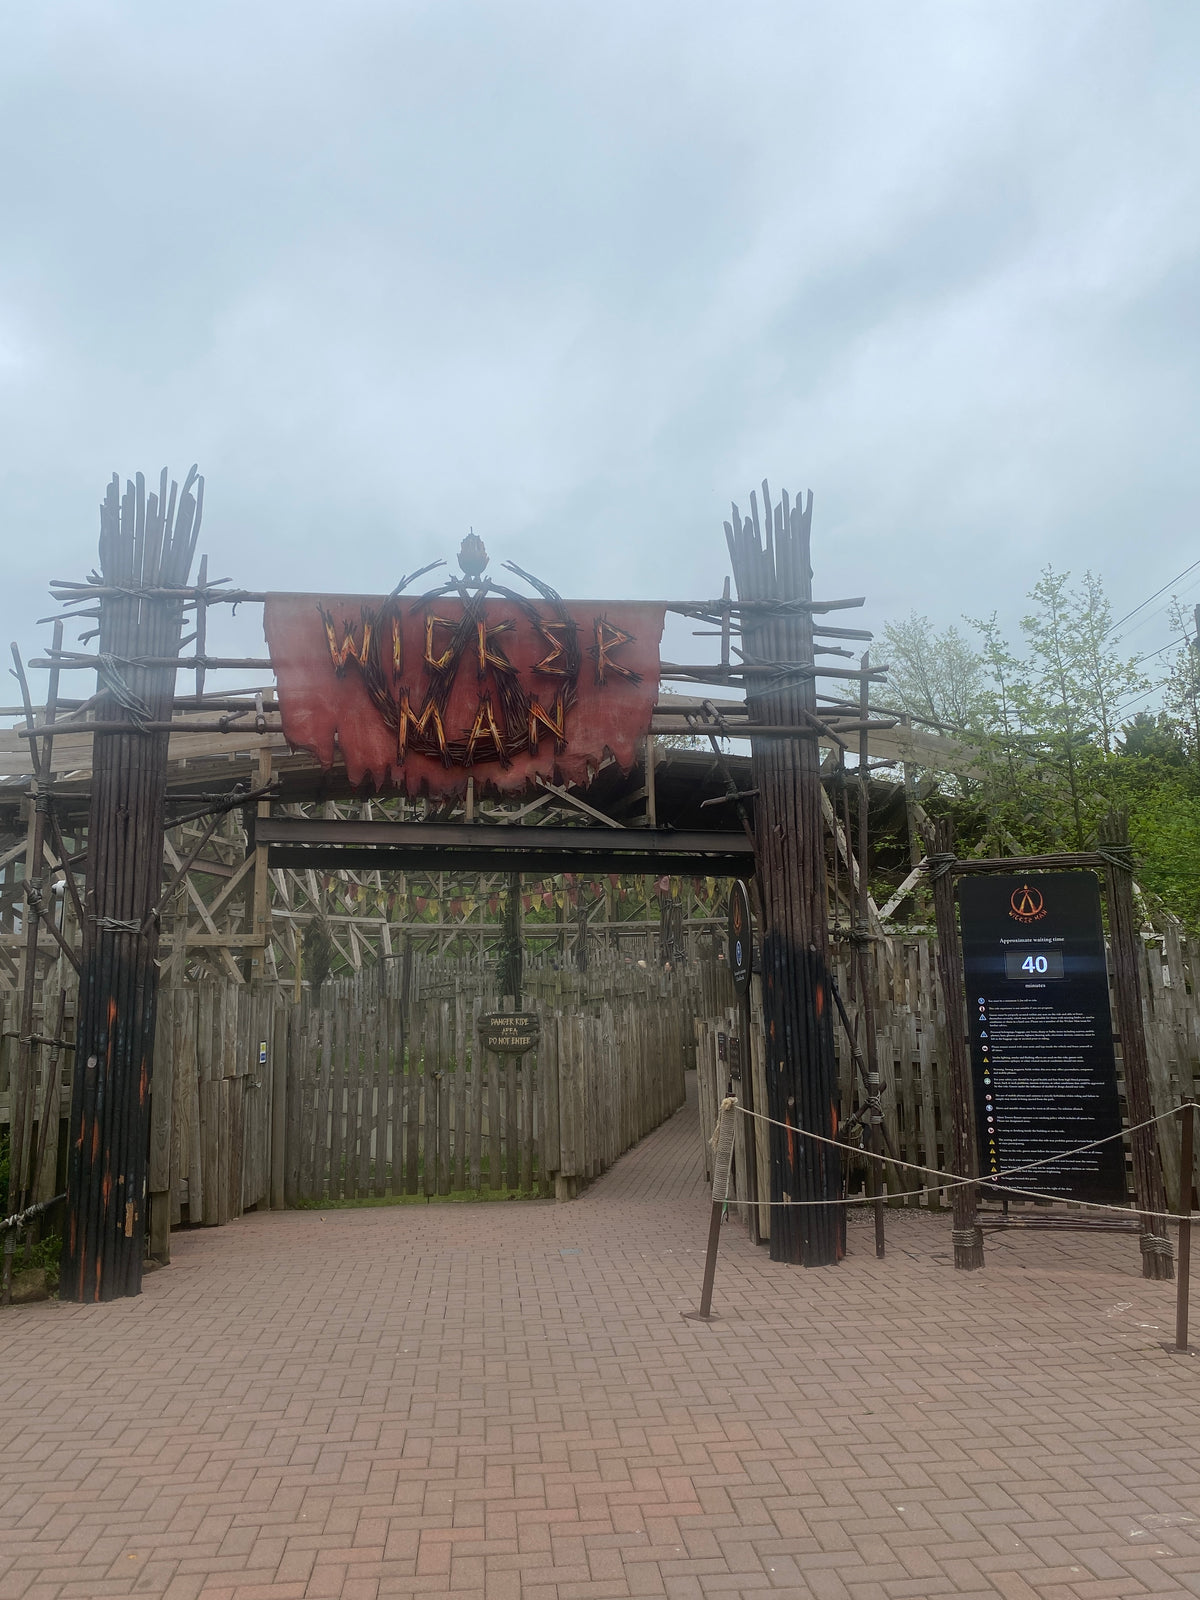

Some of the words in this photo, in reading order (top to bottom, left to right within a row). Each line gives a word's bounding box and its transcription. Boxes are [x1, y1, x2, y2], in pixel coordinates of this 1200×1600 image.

[316, 600, 644, 688] WICKER
[396, 685, 568, 770] MAN
[1021, 955, 1048, 974] 40
[490, 1018, 514, 1026] DANGER
[515, 1018, 529, 1026] RIDE
[502, 1027, 518, 1035] AREA
[489, 1037, 497, 1045] DO
[498, 1037, 510, 1045] NOT
[511, 1037, 530, 1045] ENTER
